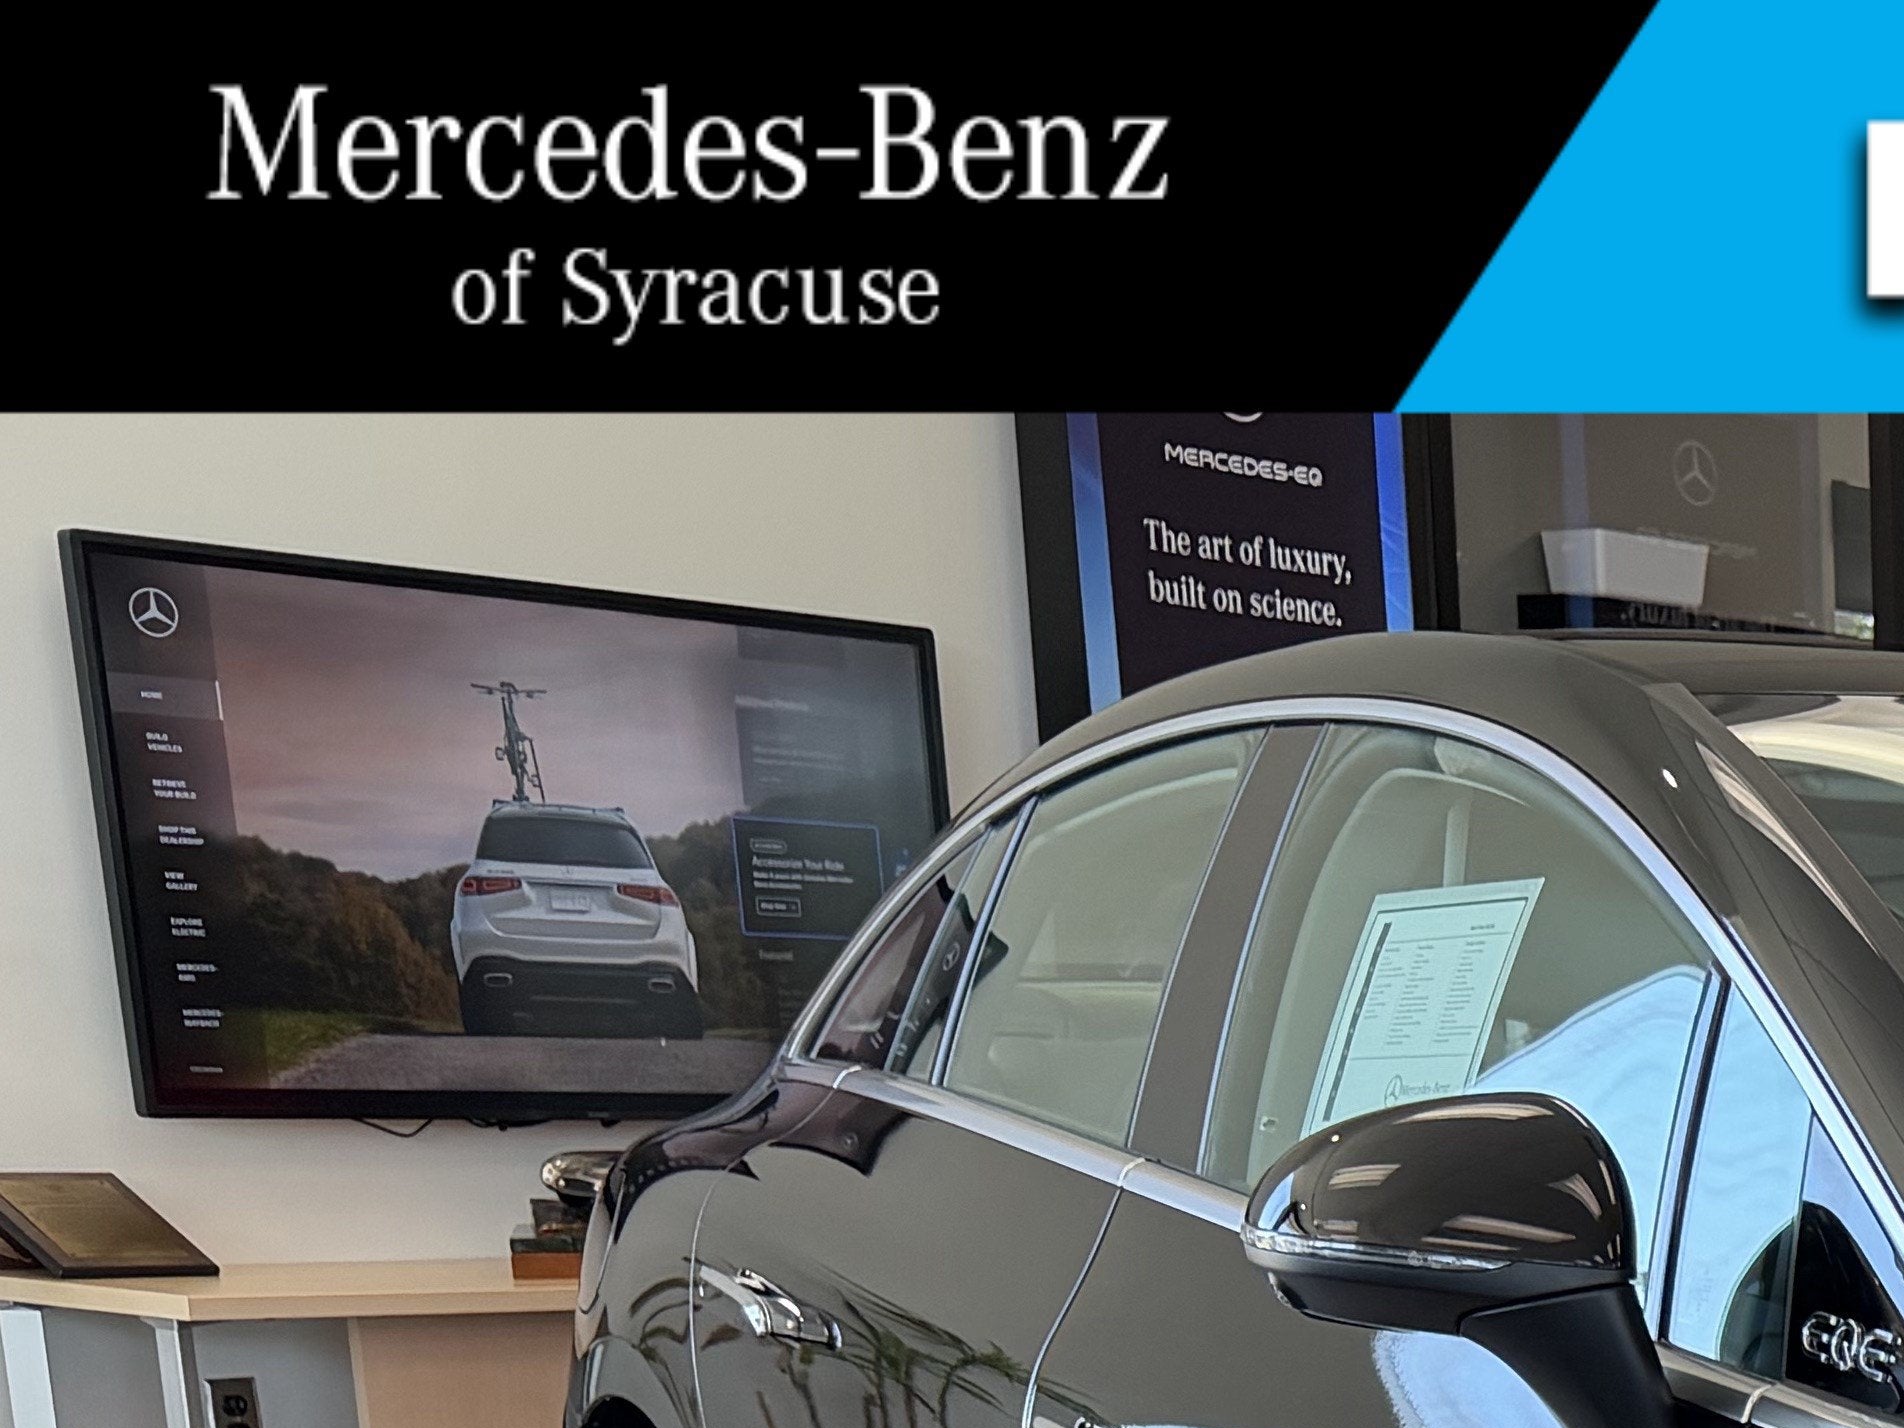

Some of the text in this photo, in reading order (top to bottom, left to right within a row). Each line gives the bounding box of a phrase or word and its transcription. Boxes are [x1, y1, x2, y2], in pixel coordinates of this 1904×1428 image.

[1164, 443, 1322, 487] MERCEDES-EQ
[1143, 517, 1352, 585] The art of luxury,
[1148, 570, 1342, 627] built on science.
